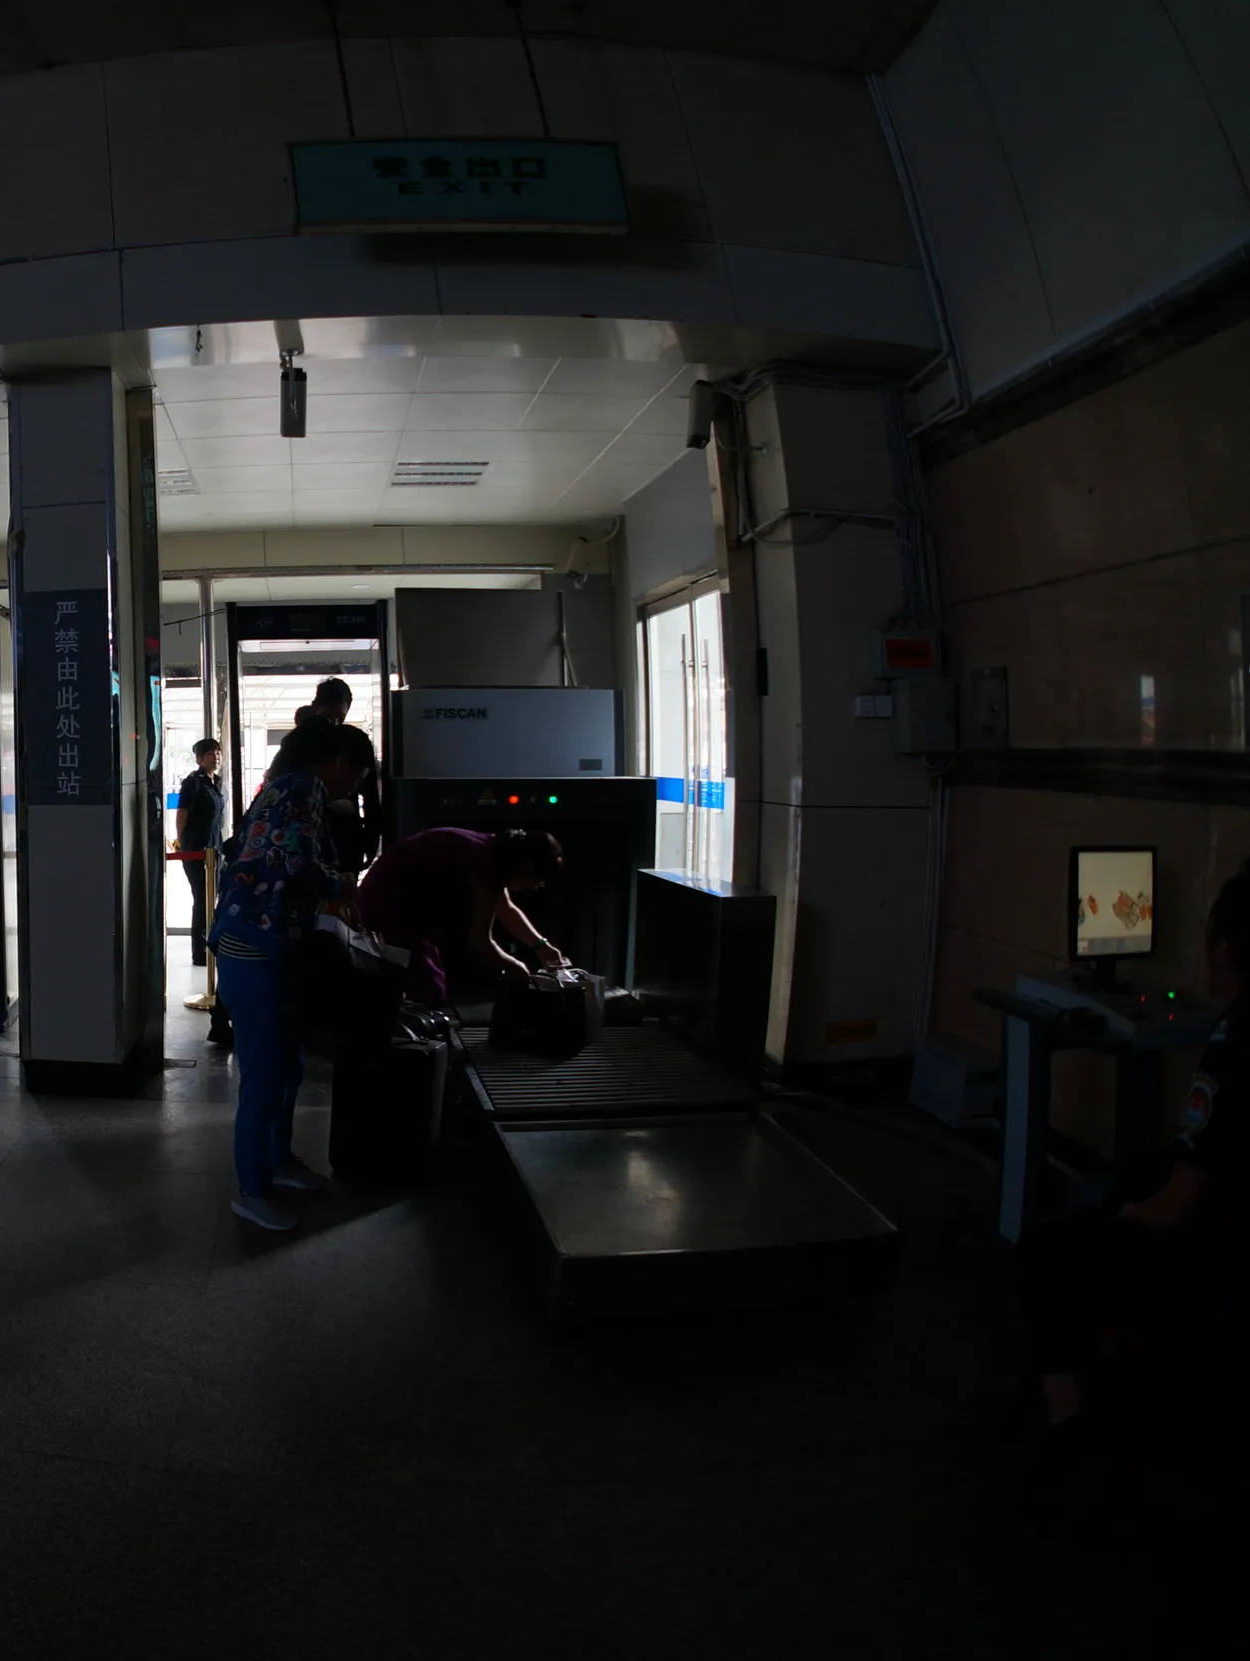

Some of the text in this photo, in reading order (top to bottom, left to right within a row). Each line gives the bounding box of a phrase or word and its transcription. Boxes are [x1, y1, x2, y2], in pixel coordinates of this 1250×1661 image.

[372, 157, 547, 178] 安全出口
[399, 181, 528, 195] EXIT
[54, 600, 81, 797] 严禁由此处出站
[436, 708, 486, 719] FISCAN
